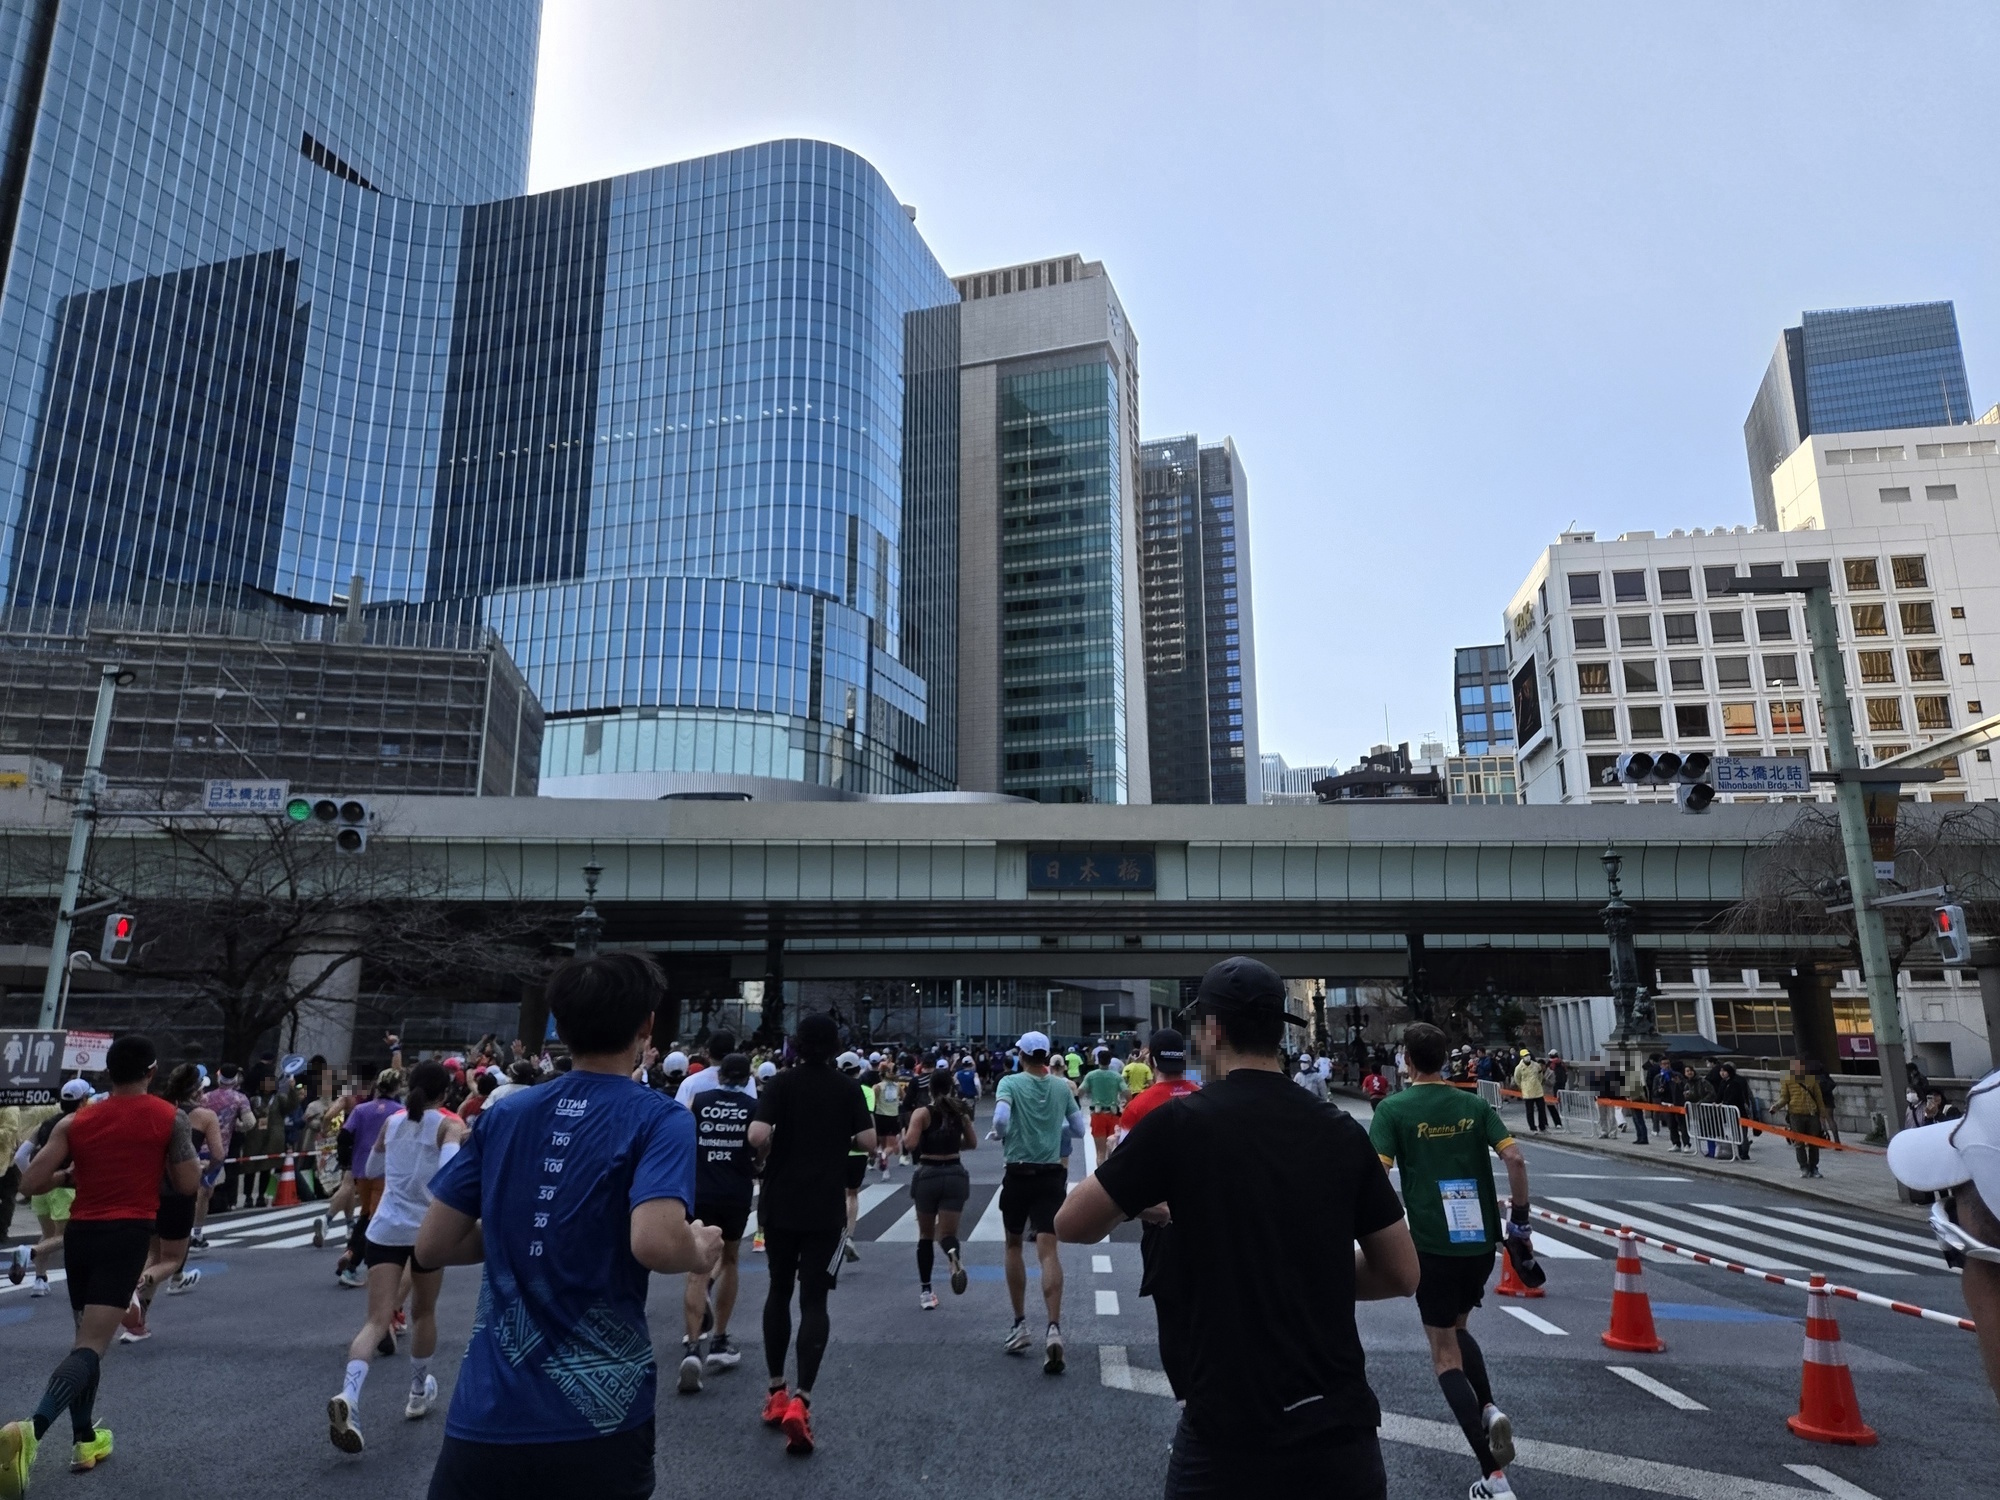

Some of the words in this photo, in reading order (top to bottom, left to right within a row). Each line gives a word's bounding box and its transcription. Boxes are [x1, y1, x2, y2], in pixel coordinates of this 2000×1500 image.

[1715, 757, 1741, 765] 中央区
[1717, 765, 1802, 780] 日本橋北詰
[1718, 781, 1765, 789] Nihonbashi
[210, 787, 281, 800] 日本橋北詰
[1046, 857, 1141, 882] 日本橋
[557, 1098, 588, 1110] UTMB
[701, 1106, 748, 1120] COPEC
[715, 1123, 746, 1132] GWM
[1417, 1121, 1456, 1139] Running
[551, 1135, 571, 1147] 160
[707, 1150, 732, 1162] pax
[543, 1161, 563, 1173] 100
[538, 1189, 555, 1201] 50
[533, 1217, 548, 1228] 20
[529, 1245, 543, 1257] 10
